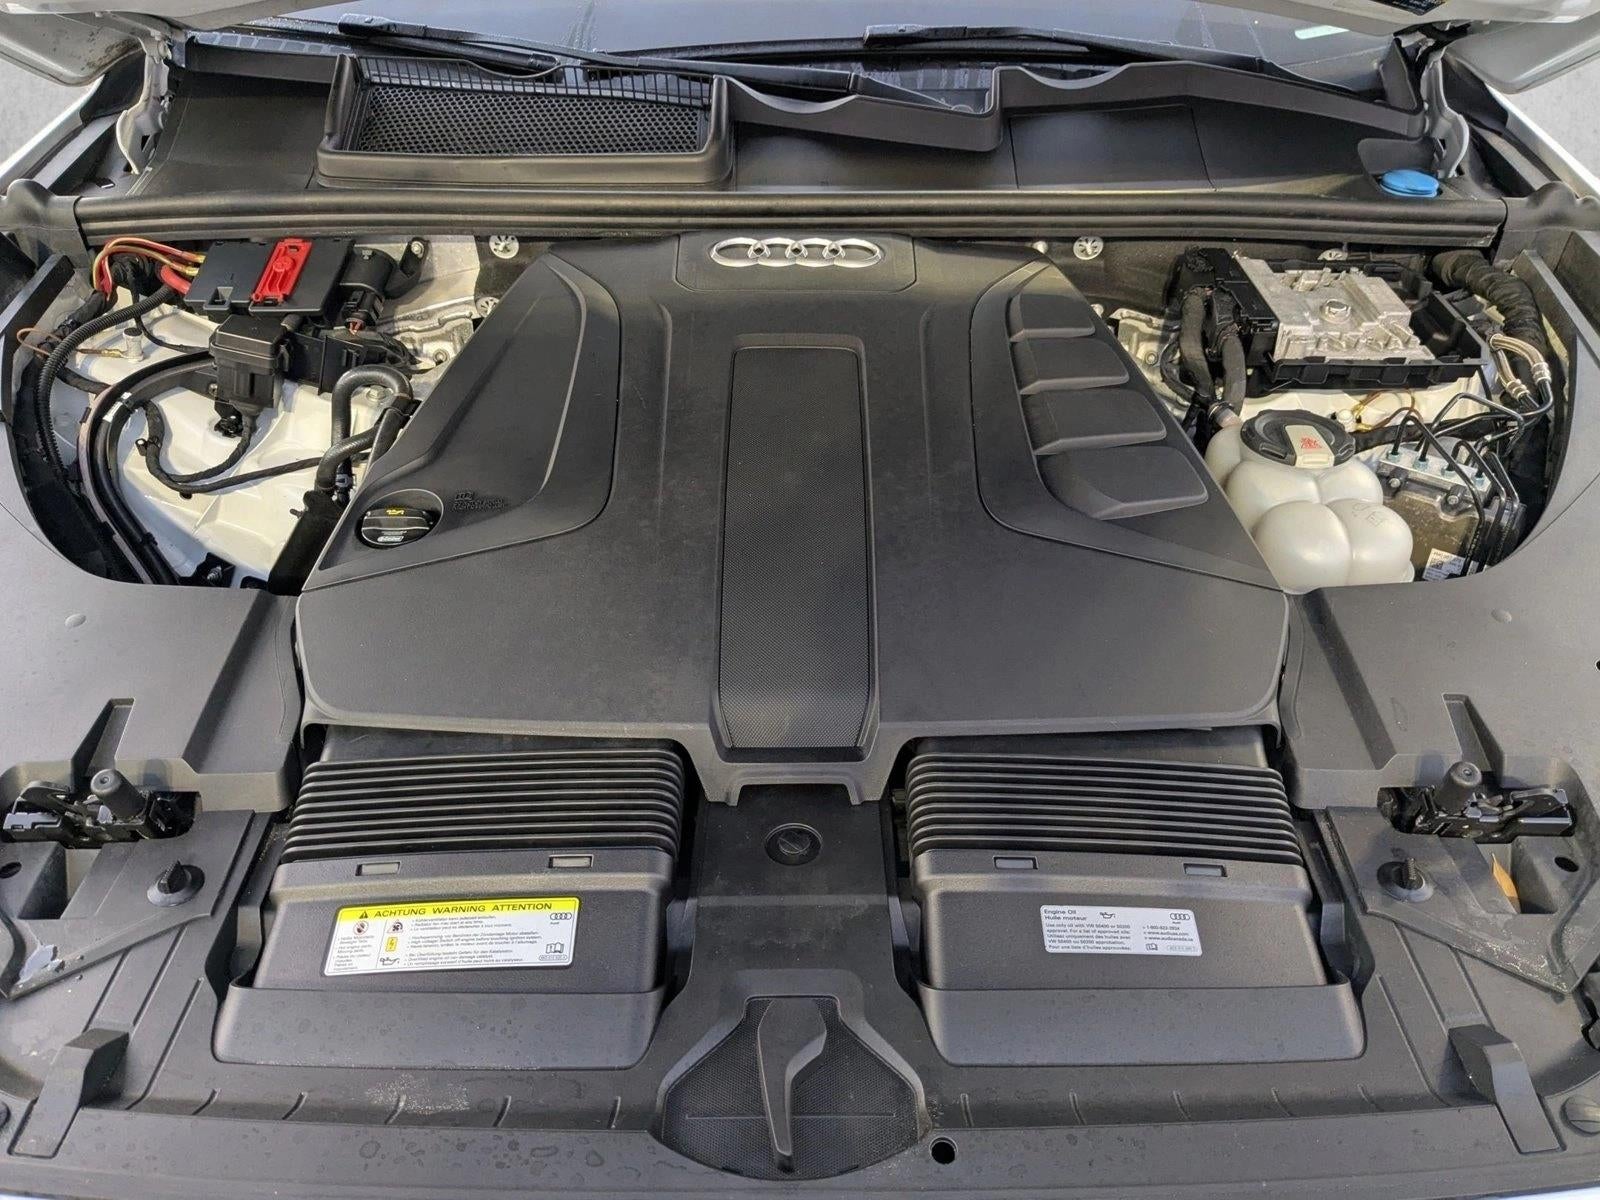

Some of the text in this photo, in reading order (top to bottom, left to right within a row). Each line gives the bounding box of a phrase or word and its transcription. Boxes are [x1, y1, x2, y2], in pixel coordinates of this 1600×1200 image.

[374, 902, 553, 918] ACHTUNG WARNING ATTENTION
